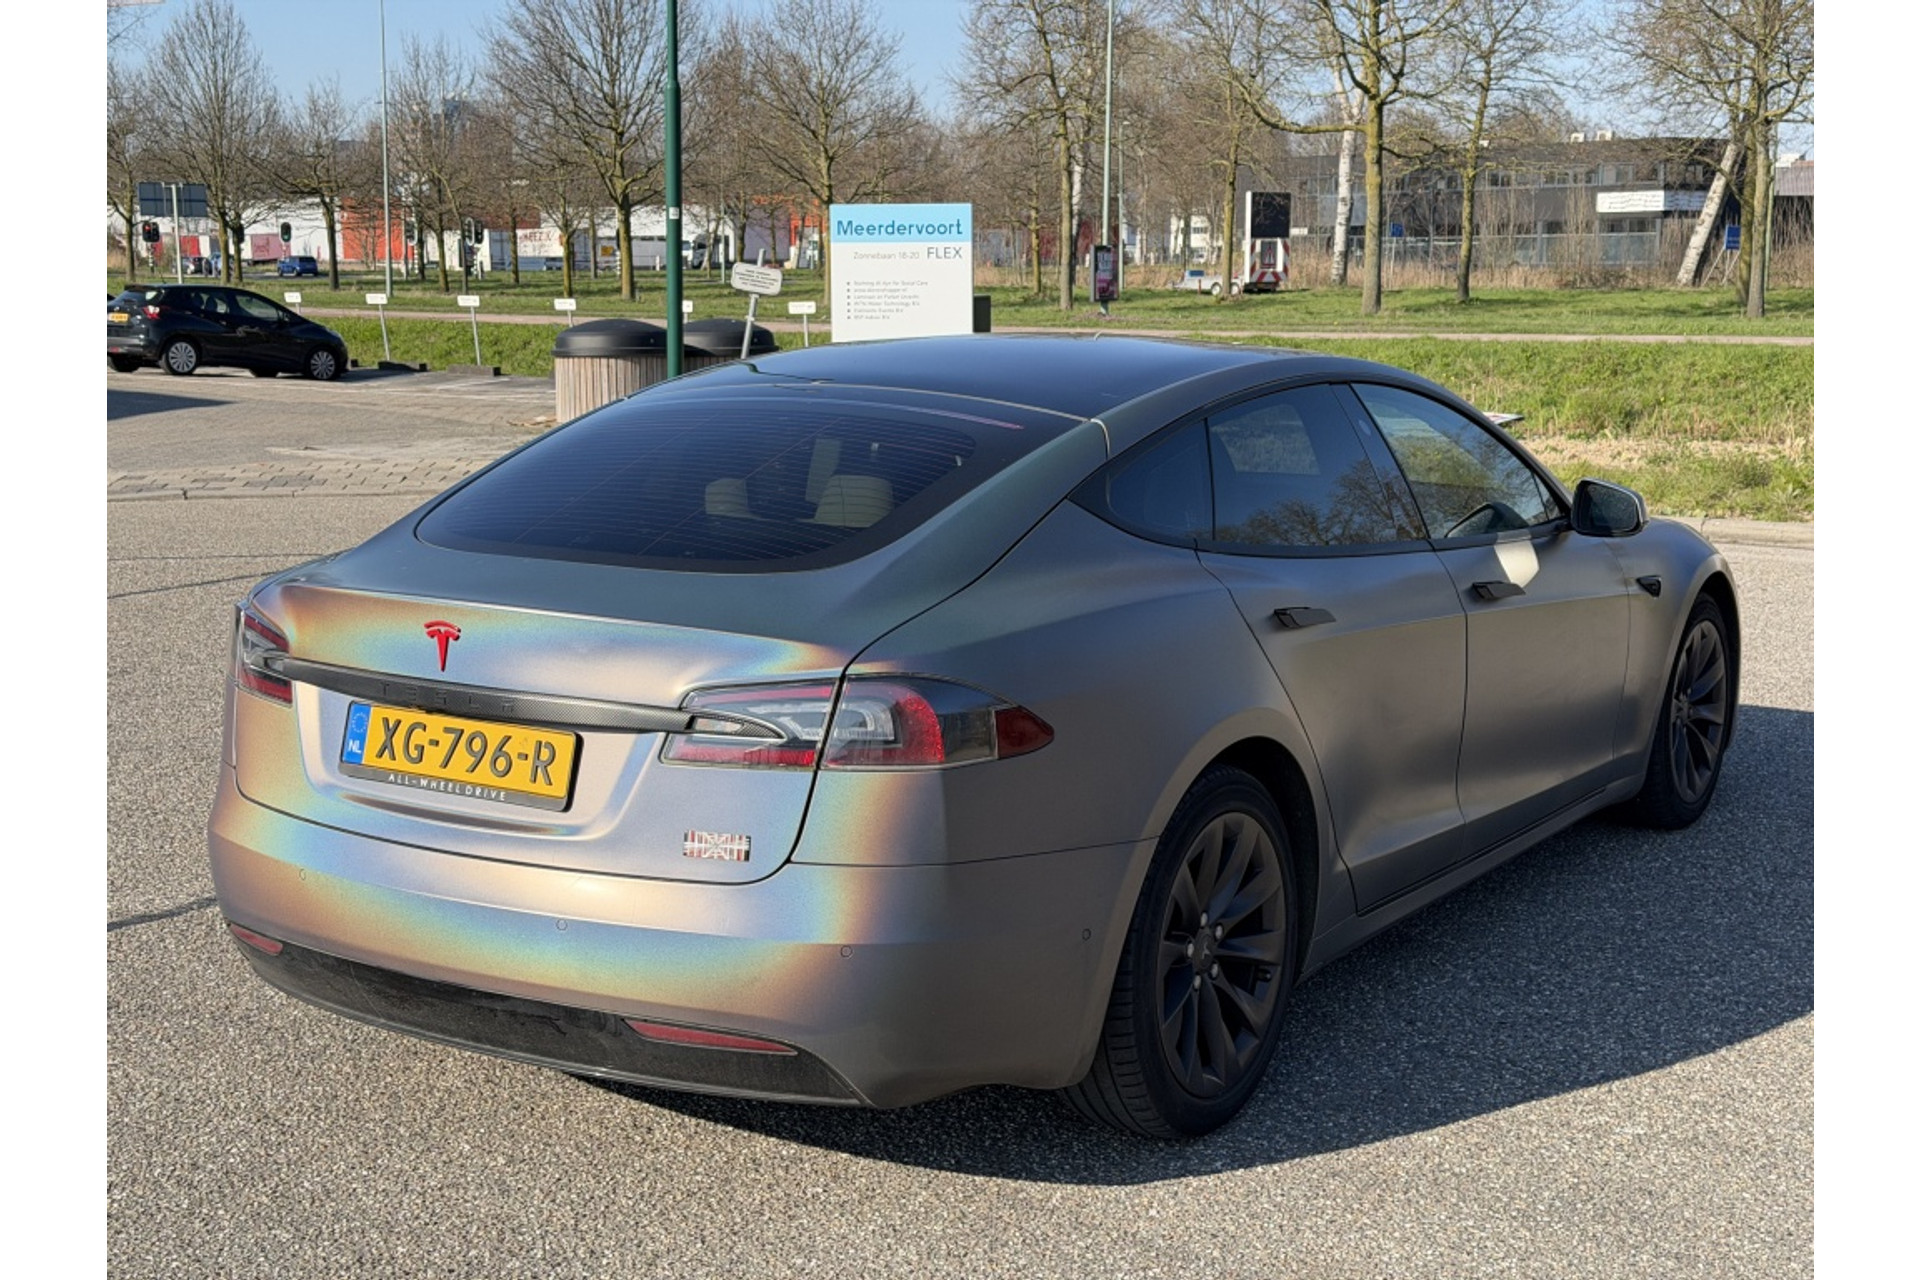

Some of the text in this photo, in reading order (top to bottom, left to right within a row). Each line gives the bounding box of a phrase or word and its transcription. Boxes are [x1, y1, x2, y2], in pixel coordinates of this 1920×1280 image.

[837, 218, 963, 236] Meerdervoort
[926, 246, 963, 260] FLEX
[348, 738, 362, 754] NL
[375, 716, 556, 786] XG-796-R
